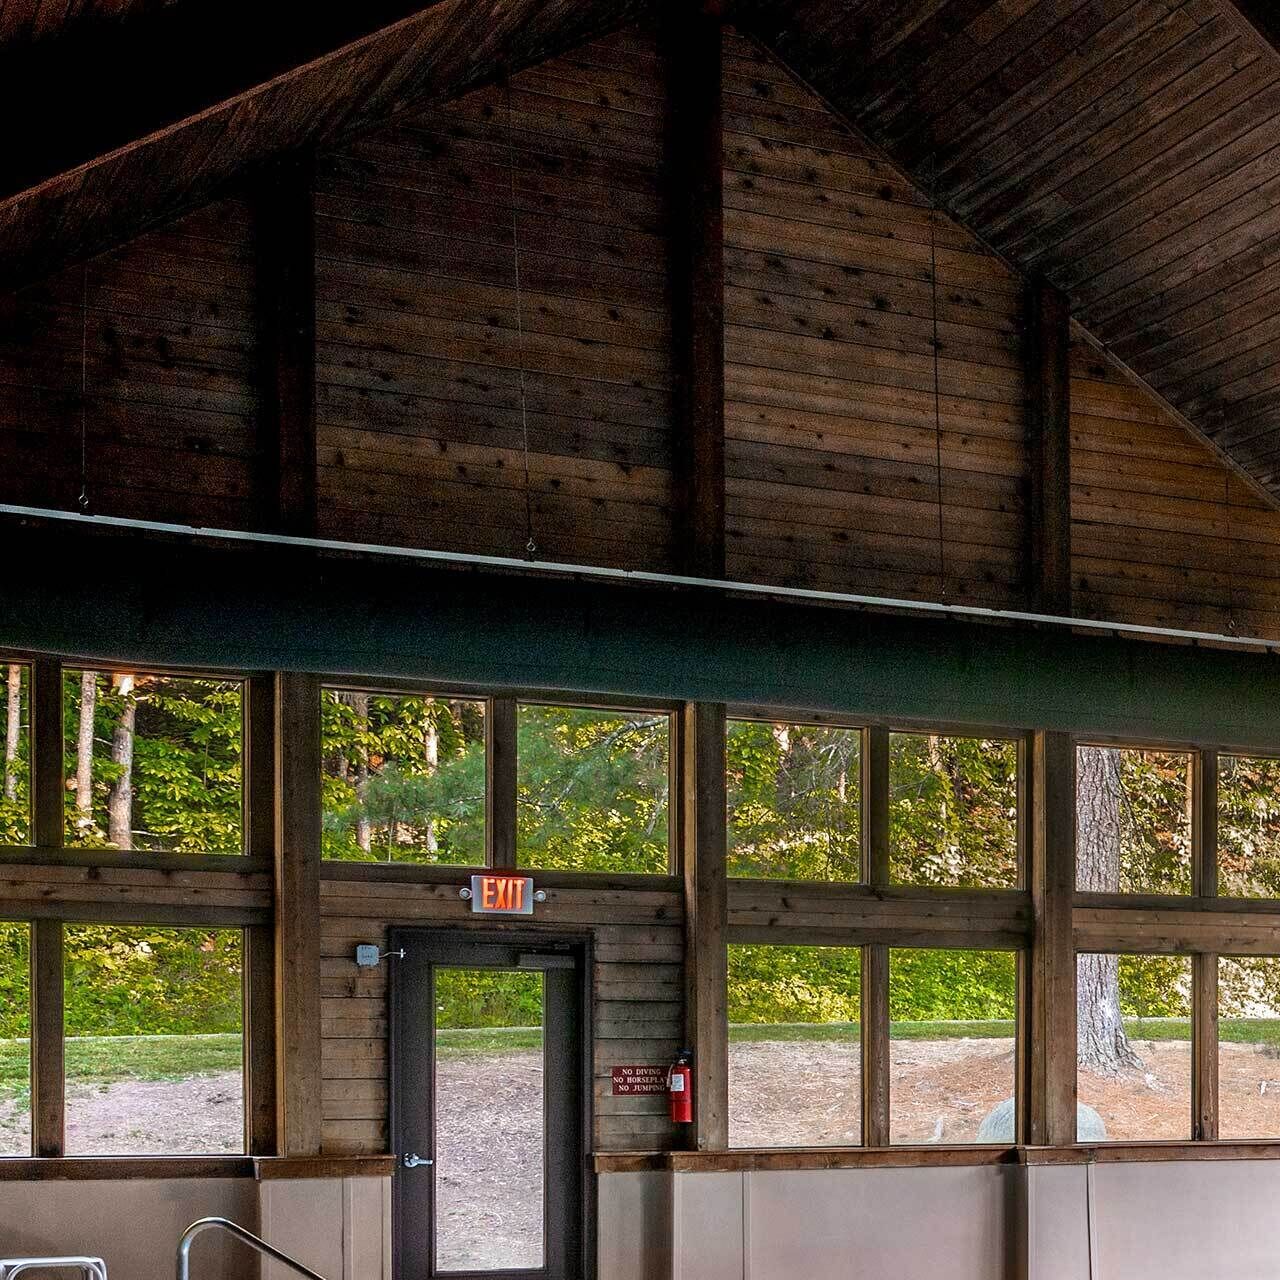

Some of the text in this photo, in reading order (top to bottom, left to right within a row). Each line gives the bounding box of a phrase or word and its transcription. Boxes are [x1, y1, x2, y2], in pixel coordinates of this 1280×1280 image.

[482, 878, 525, 910] EXIT
[622, 1068, 632, 1076] NO
[627, 1076, 667, 1084] HORSEPLA
